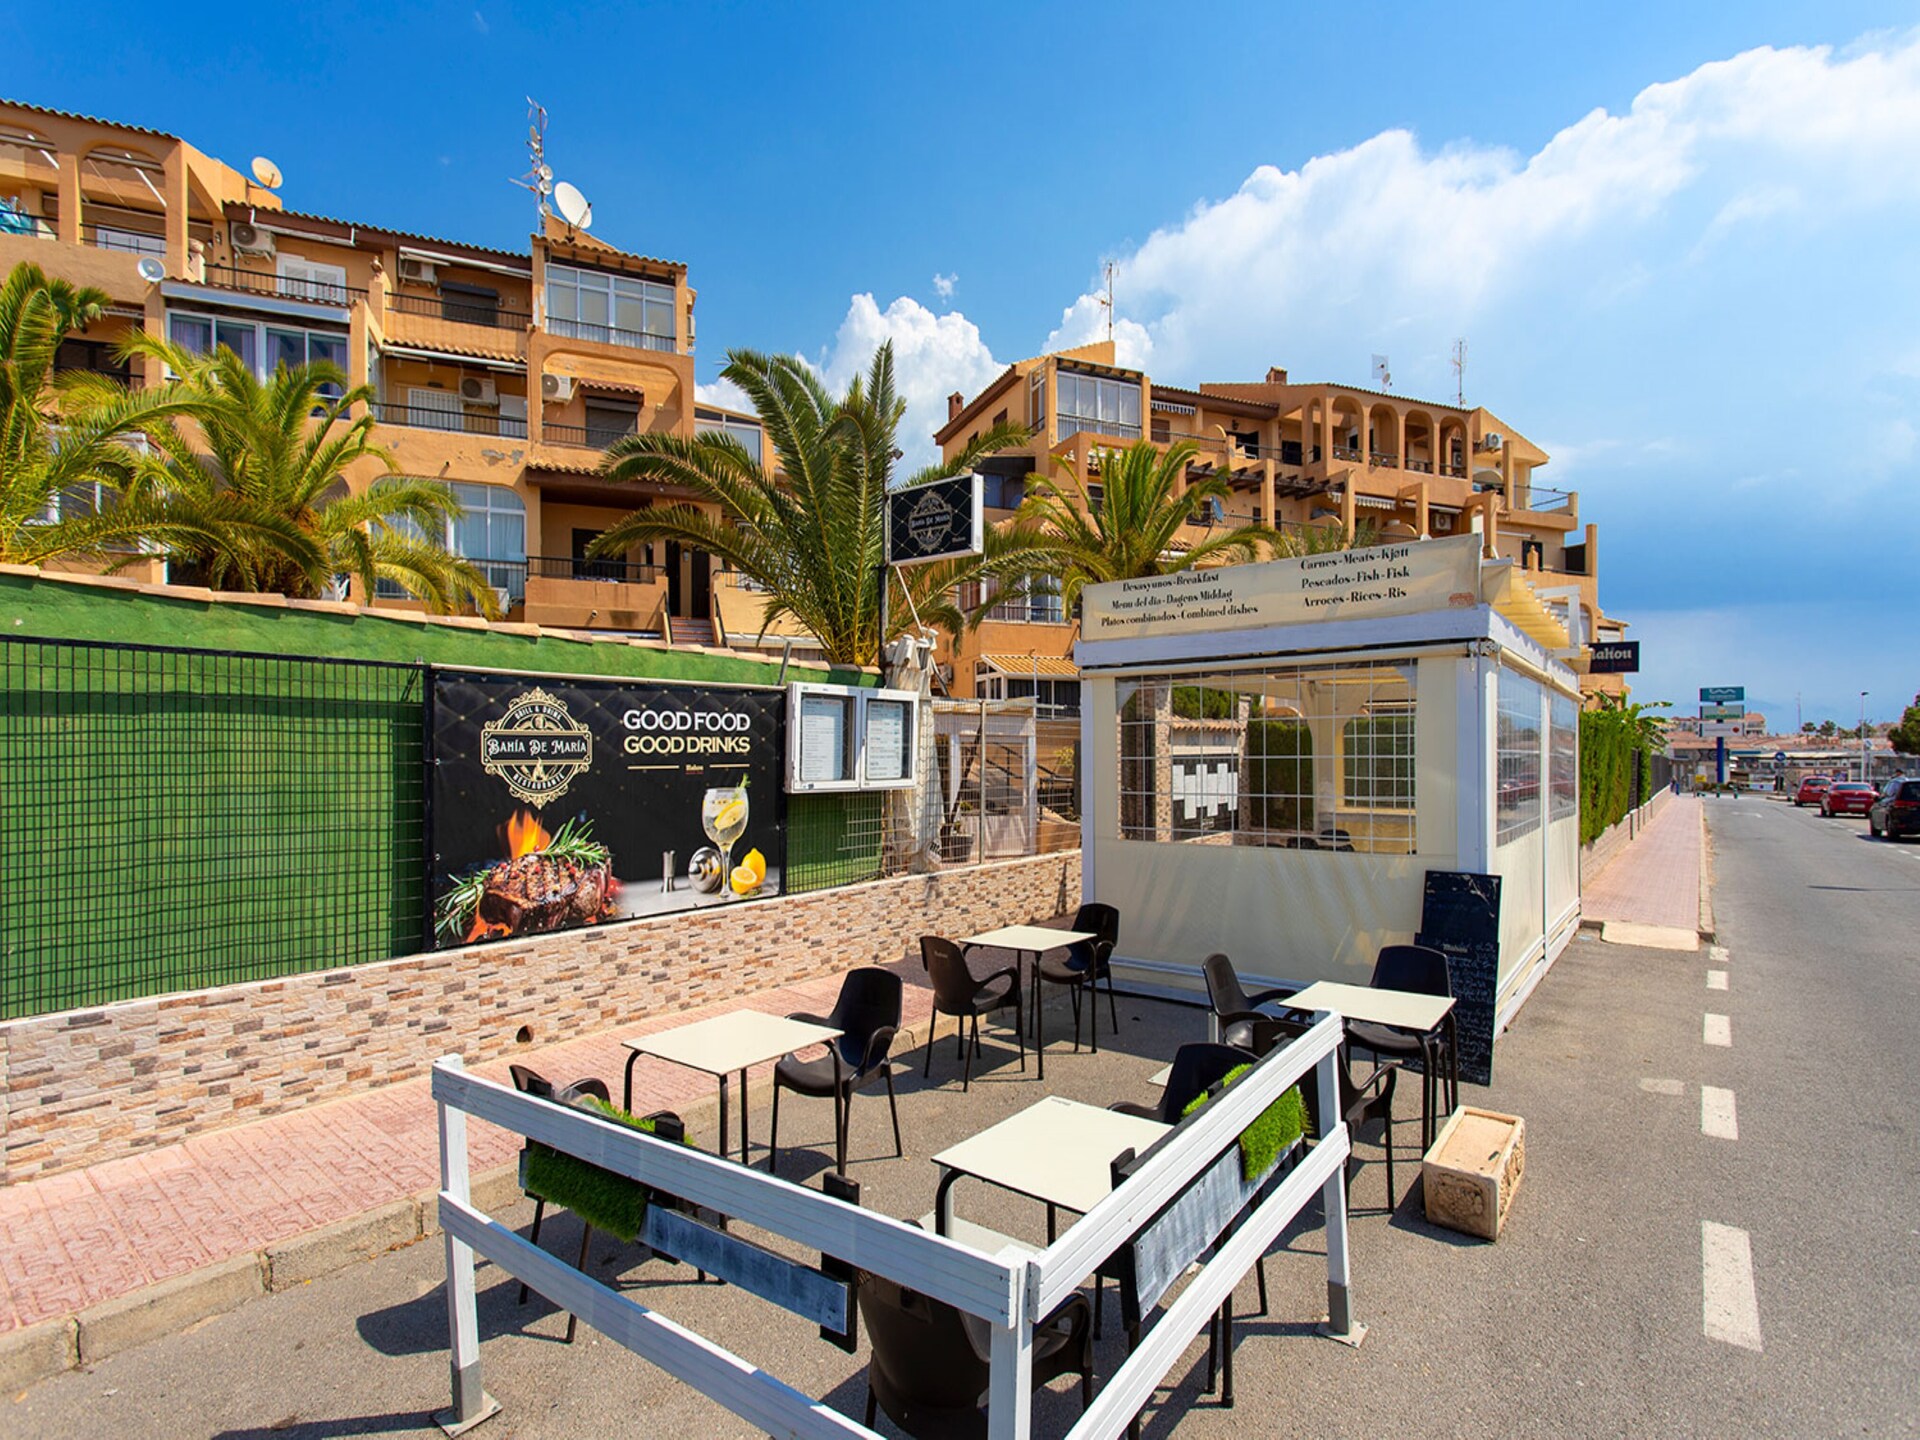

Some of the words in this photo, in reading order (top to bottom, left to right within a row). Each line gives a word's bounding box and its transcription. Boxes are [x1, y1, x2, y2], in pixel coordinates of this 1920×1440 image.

[1300, 559, 1337, 571] Carnes
[1343, 552, 1374, 565] Meats
[1176, 573, 1219, 585] Breakfast
[1301, 574, 1350, 589] Pescados
[1356, 568, 1380, 582] Fish
[1386, 565, 1410, 579] Fisk
[1135, 598, 1147, 608] del
[1166, 594, 1198, 608] Dagens
[1200, 589, 1232, 603] Middag
[1304, 595, 1345, 608] Arroces
[1350, 590, 1381, 603] Rices
[1388, 587, 1407, 598] Ris
[1101, 617, 1125, 627] Platos
[1126, 611, 1176, 624] combinados
[1180, 605, 1226, 620] Combined
[1227, 603, 1258, 616] dishes
[623, 709, 692, 731] GOOD
[694, 711, 751, 732] FOOD
[623, 735, 685, 754] GOOD
[686, 736, 751, 754] DRINKS
